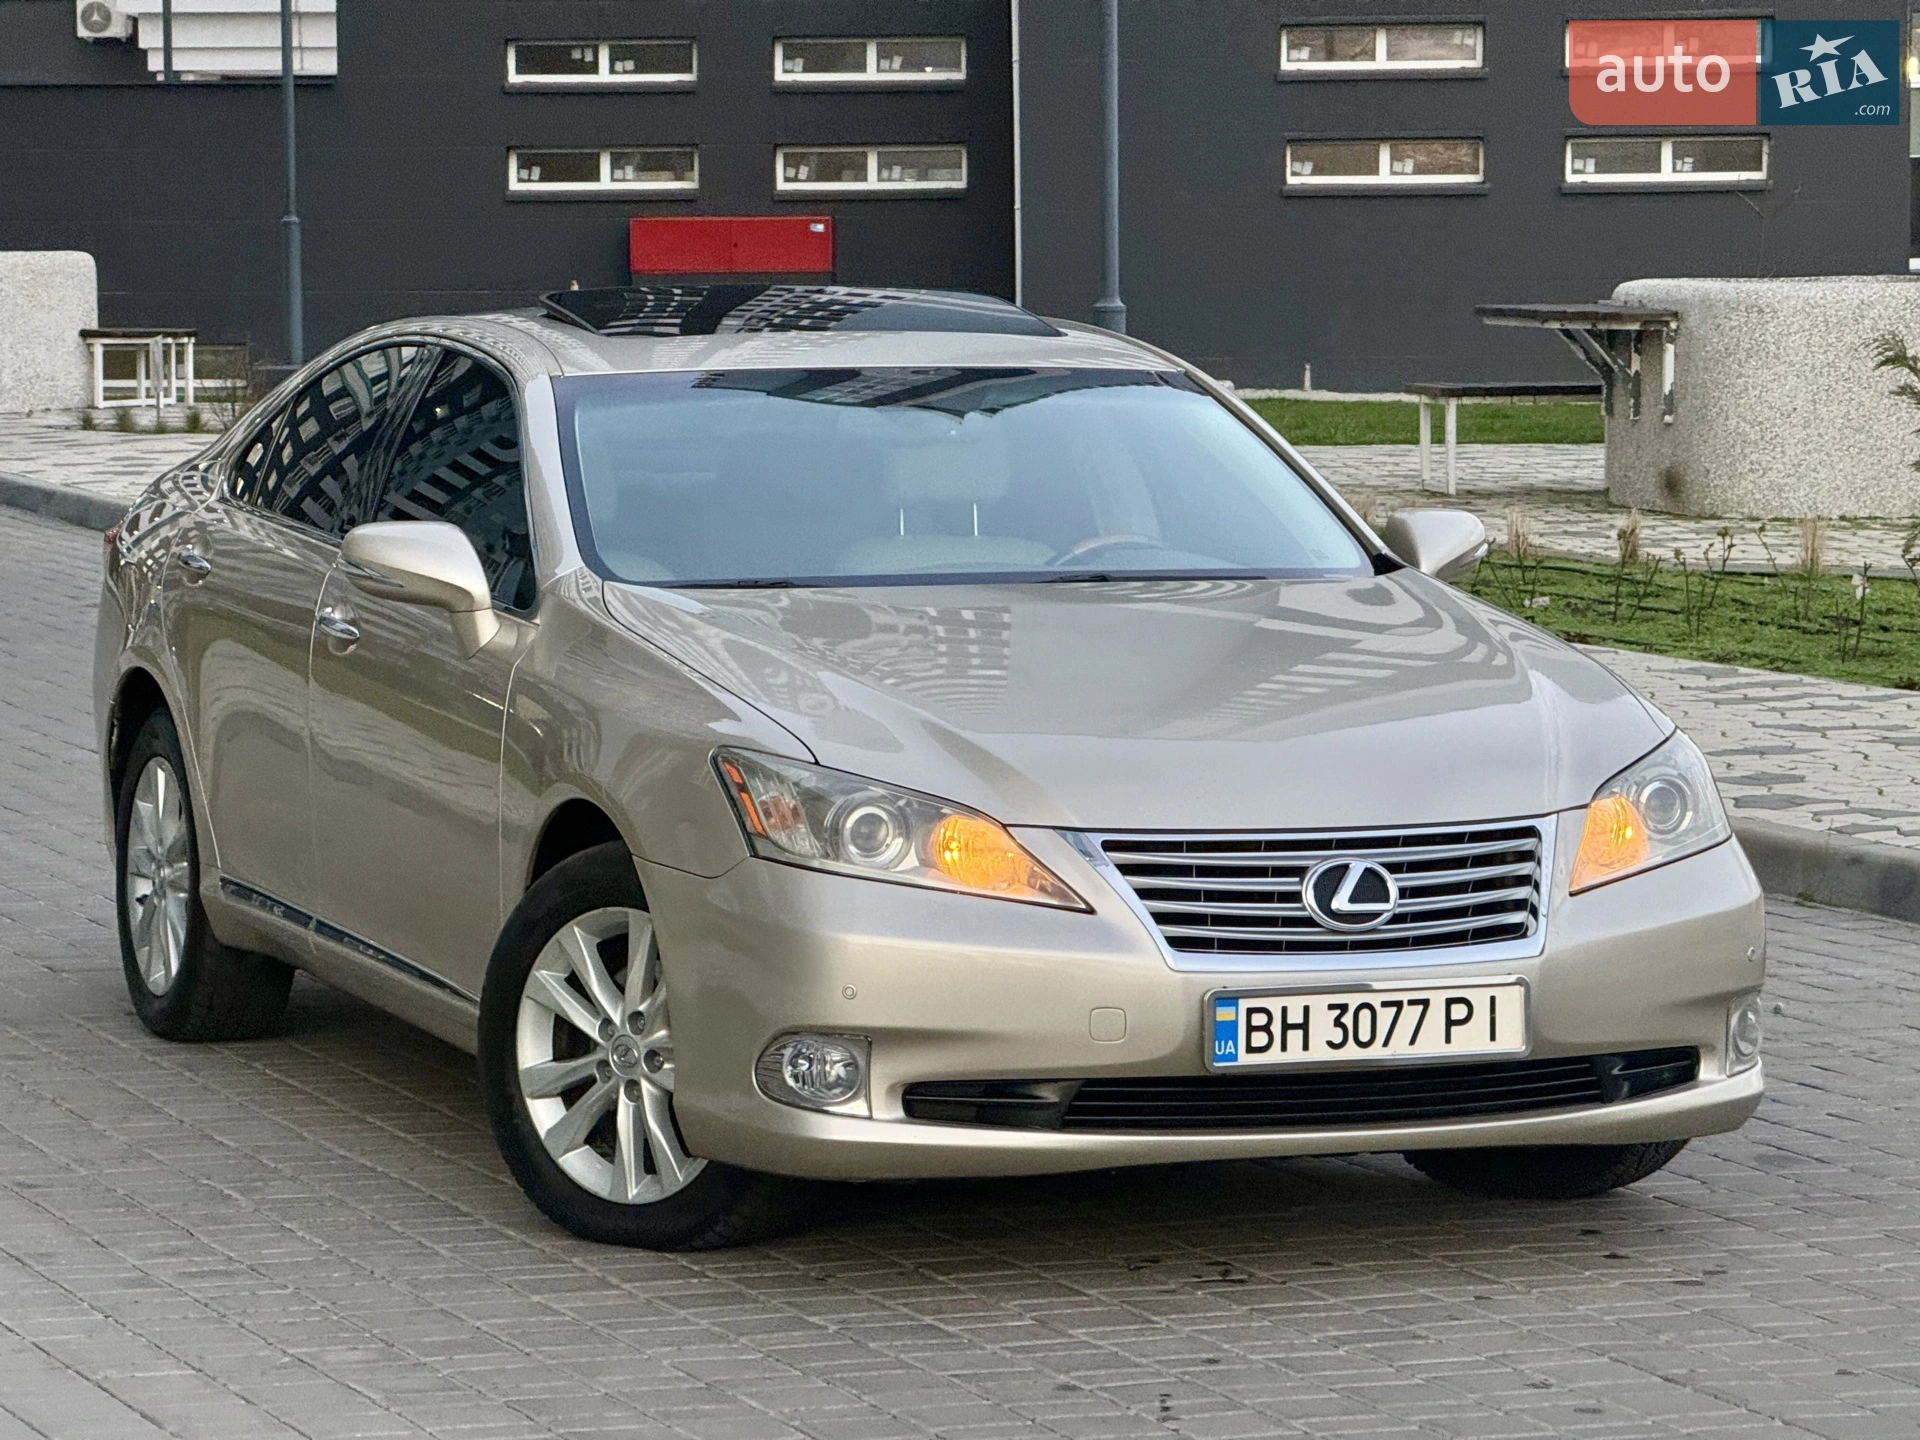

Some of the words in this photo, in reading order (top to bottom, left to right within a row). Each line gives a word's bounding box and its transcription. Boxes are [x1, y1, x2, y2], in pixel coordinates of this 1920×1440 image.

[1245, 1004, 1310, 1054] BH
[1326, 998, 1430, 1050] 3077
[1445, 995, 1497, 1044] PI
[1215, 1040, 1236, 1055] UA
